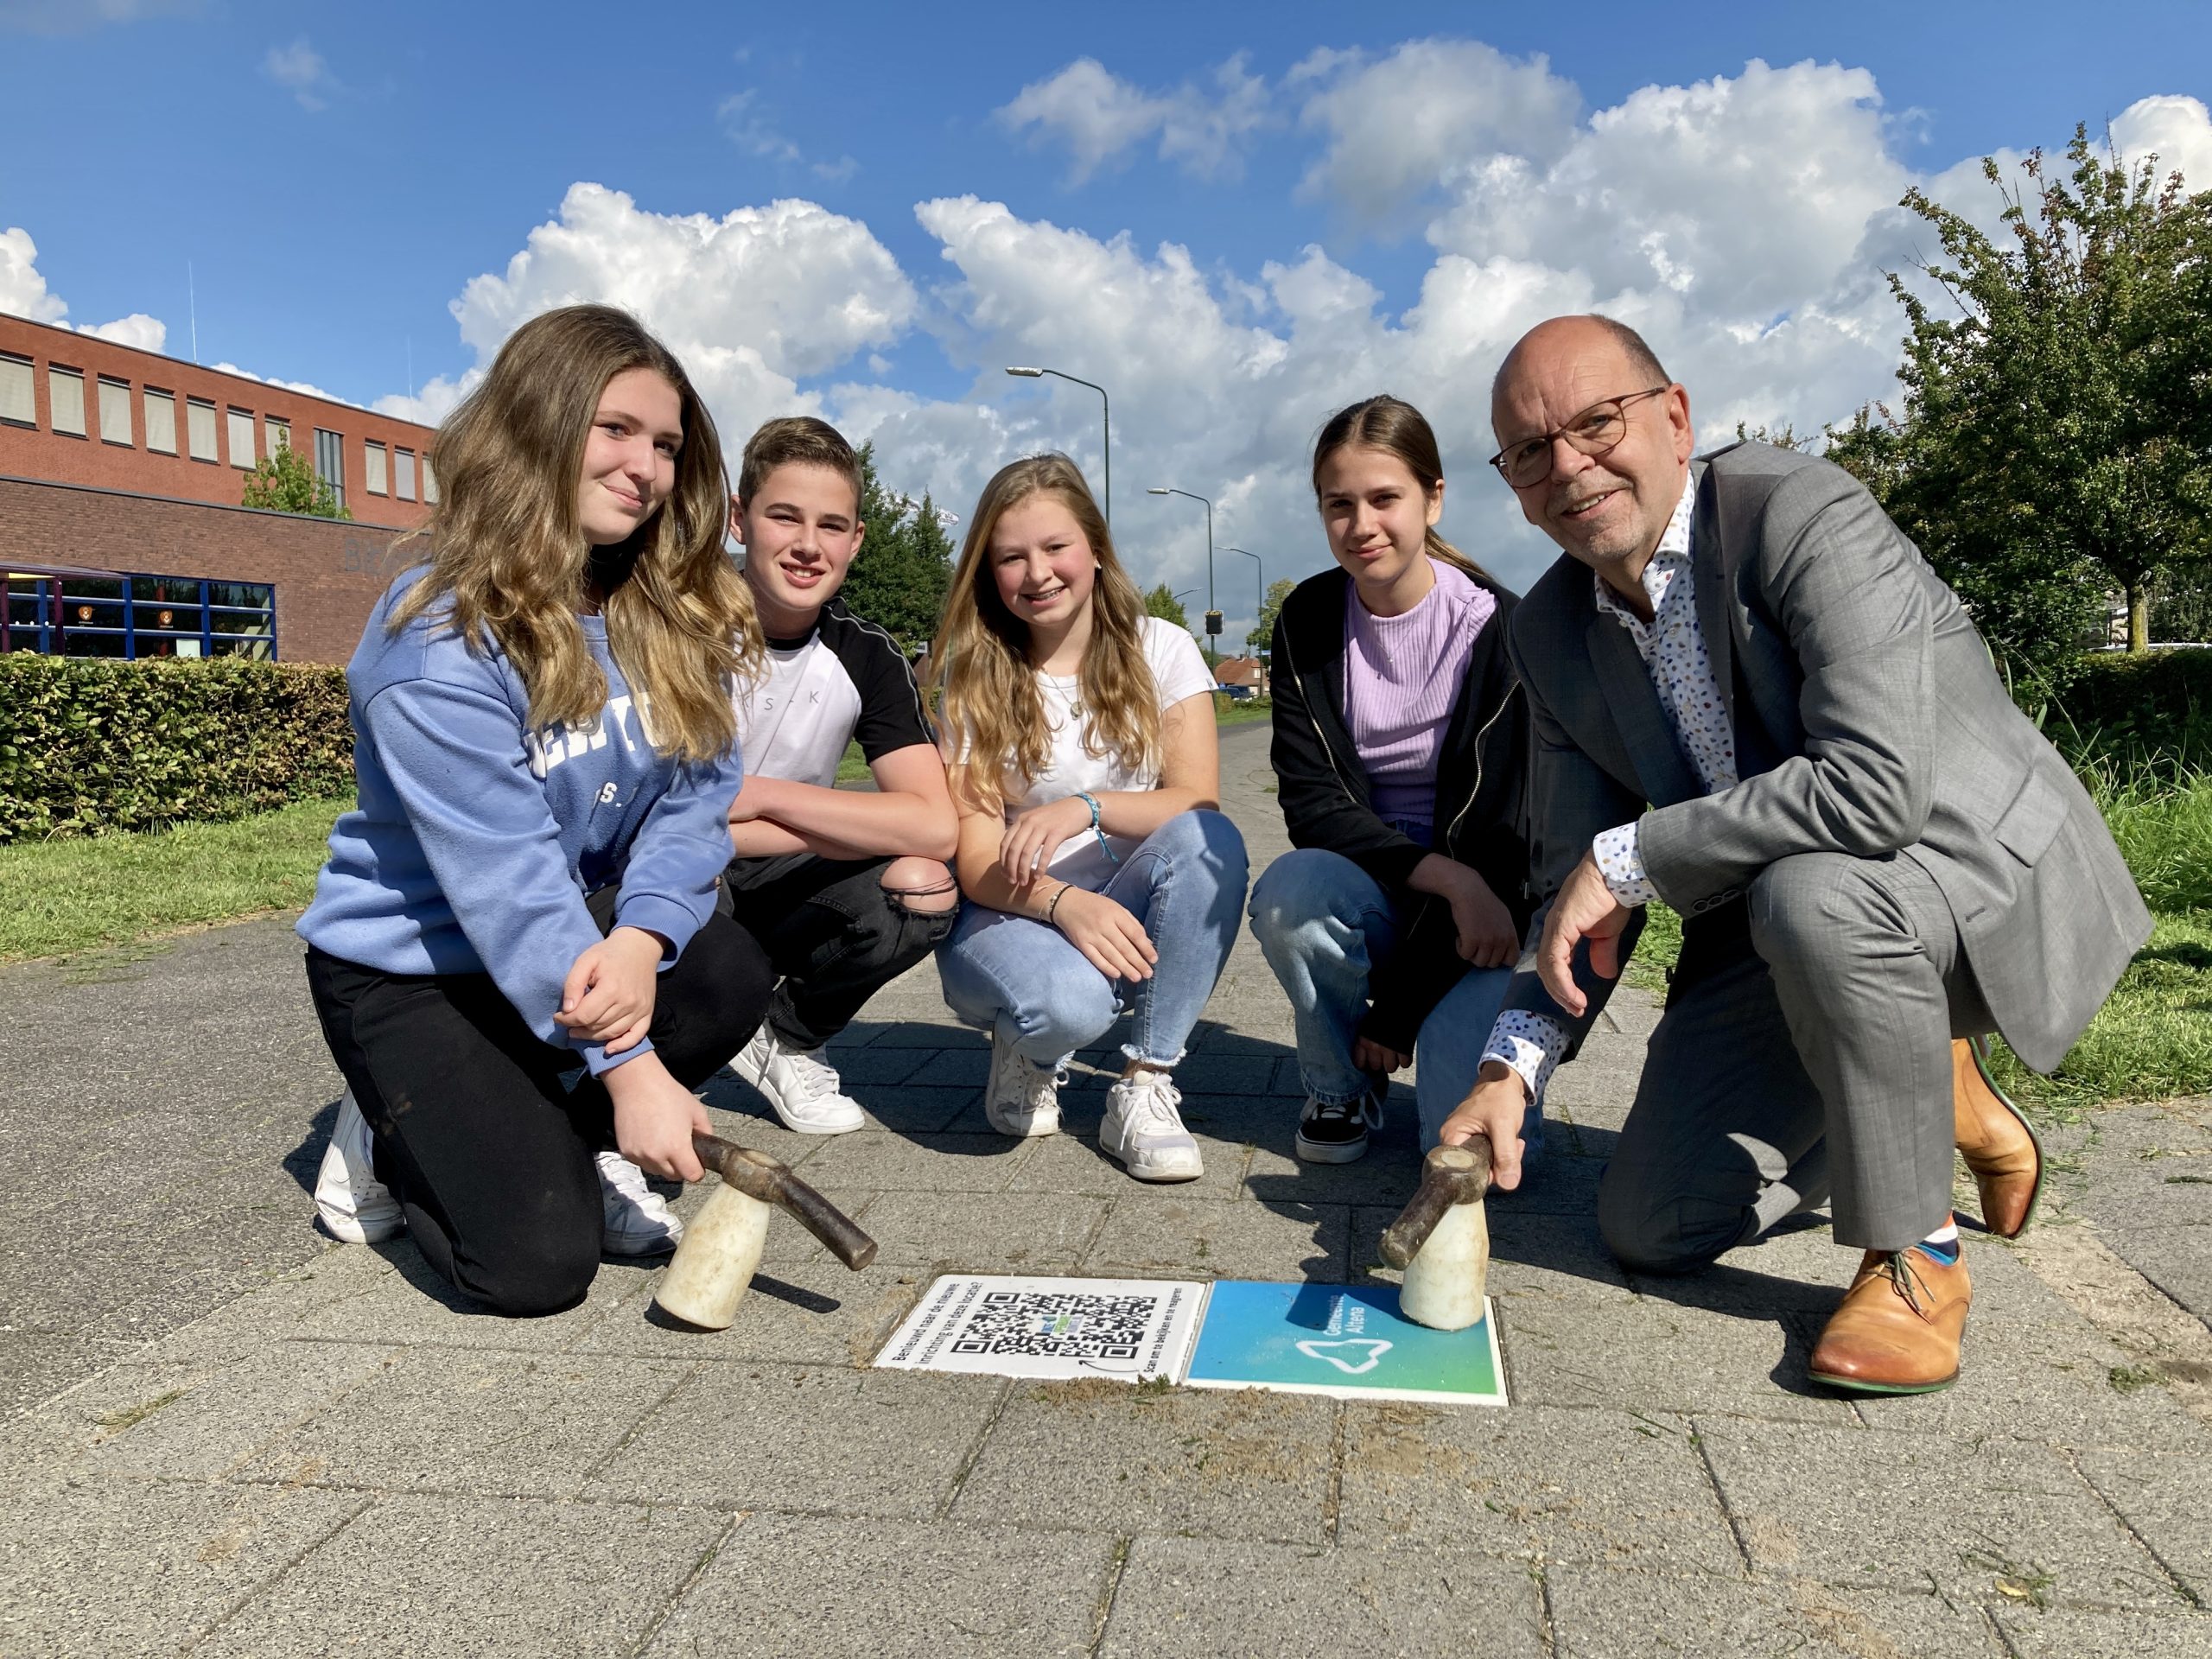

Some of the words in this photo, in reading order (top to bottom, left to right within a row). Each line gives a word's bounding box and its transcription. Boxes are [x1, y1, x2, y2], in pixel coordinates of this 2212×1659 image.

[957, 1281, 982, 1304] locatie?
[1169, 1287, 1182, 1307] reageren
[892, 1329, 927, 1361] Benieuwd
[918, 1313, 937, 1327] naar
[937, 1283, 960, 1304] nieuwe
[948, 1304, 969, 1319] deze
[1323, 1294, 1345, 1336] Gemeente
[1345, 1306, 1365, 1334] Altena
[942, 1319, 958, 1331] van
[1154, 1321, 1172, 1343] bekijken
[916, 1332, 953, 1364] inrichting
[1150, 1350, 1161, 1359] om
[1143, 1359, 1157, 1372] Scan
